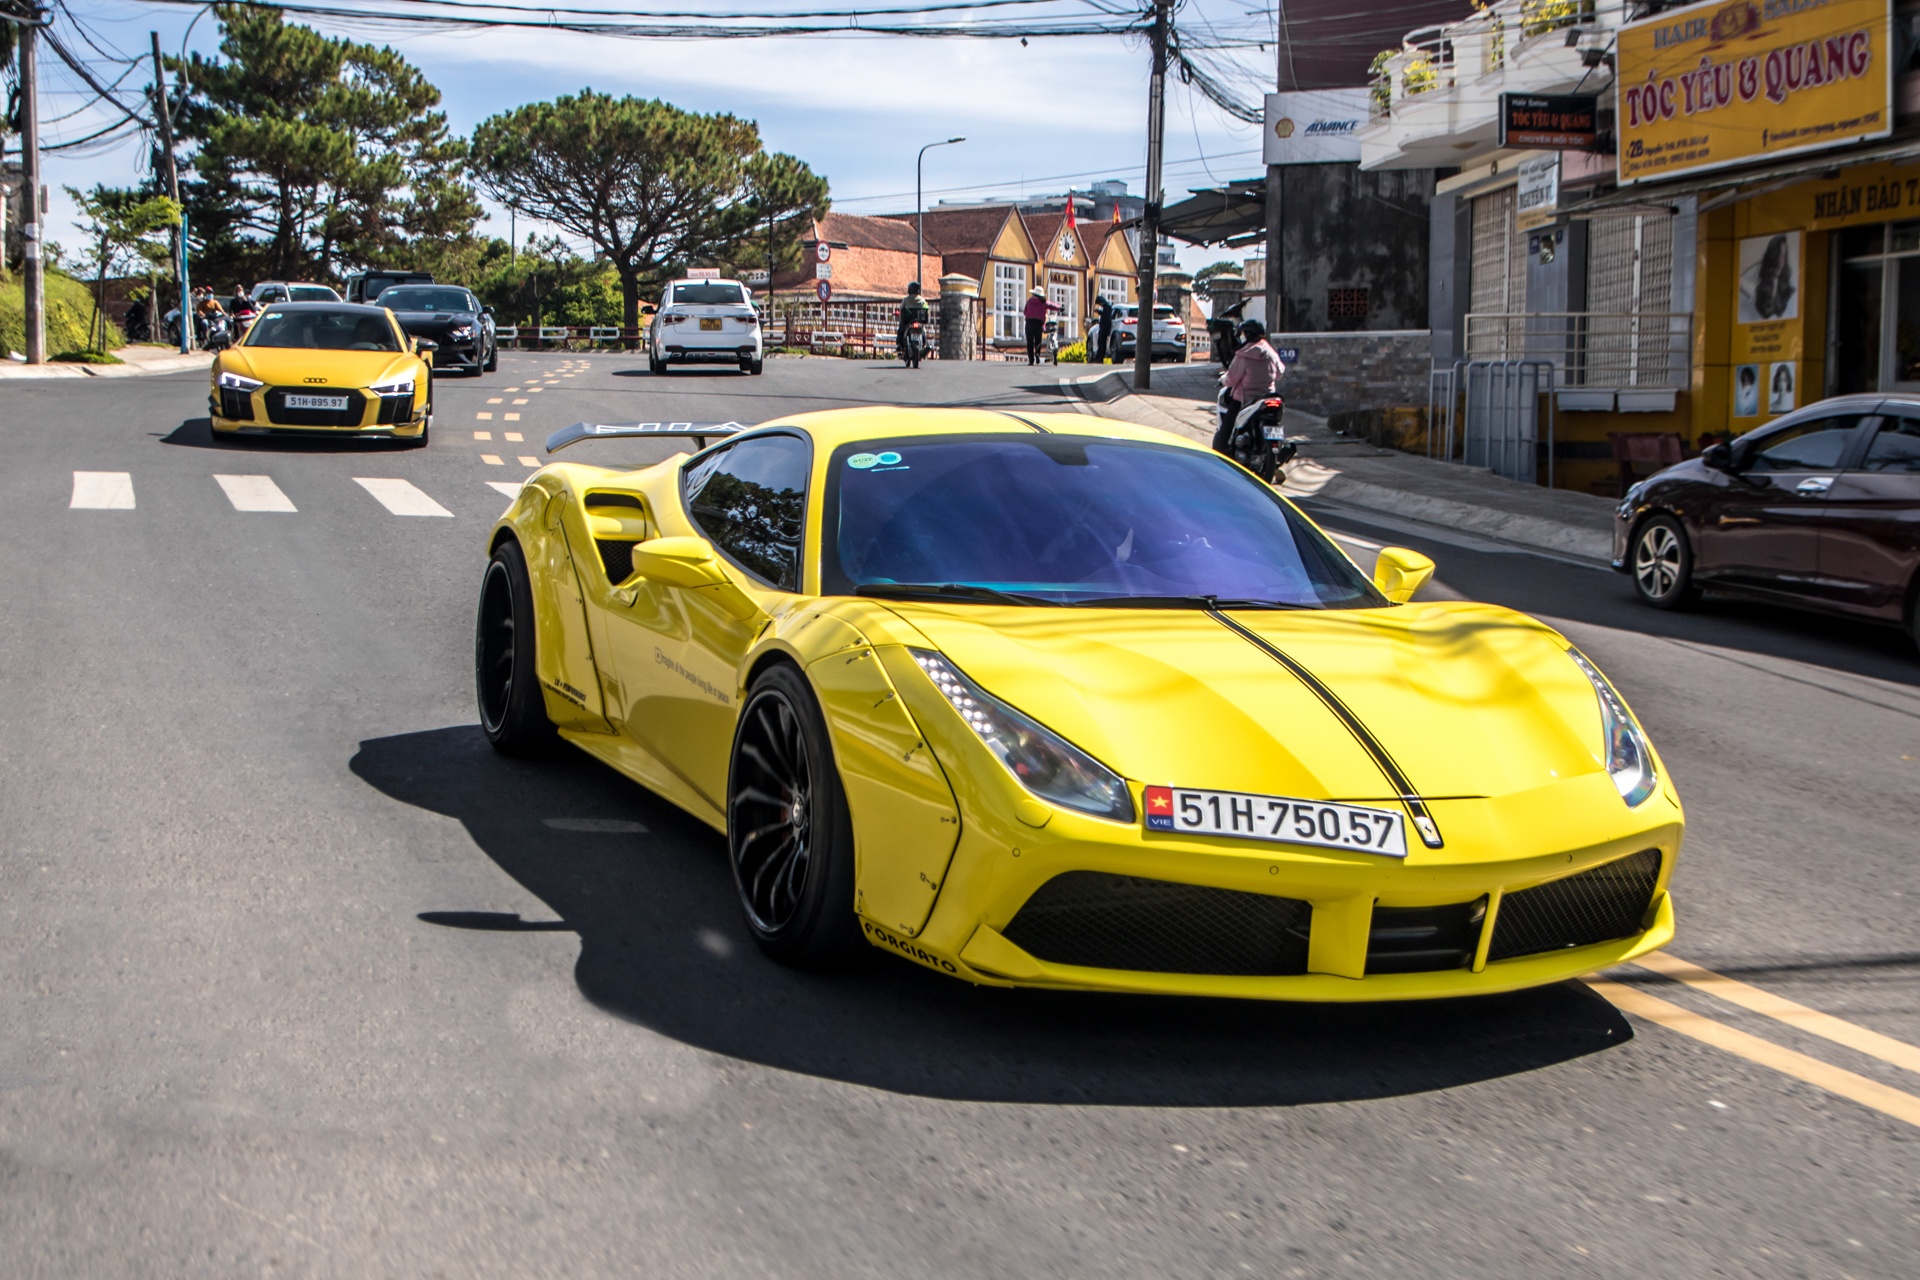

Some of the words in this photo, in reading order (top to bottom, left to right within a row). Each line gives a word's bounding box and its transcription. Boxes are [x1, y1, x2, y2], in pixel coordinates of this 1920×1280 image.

[1653, 17, 1707, 50] HAIR
[1763, 0, 1826, 20] SAL
[1626, 69, 1676, 128] TÓC
[1680, 55, 1733, 116] YÊU
[1764, 29, 1871, 105] QUANG
[1560, 113, 1591, 130] QUANG
[290, 396, 343, 407] 51H-895.97
[1151, 817, 1171, 827] VIE
[1180, 793, 1394, 848] 51H-750.57
[864, 922, 957, 974] FORGIATO
